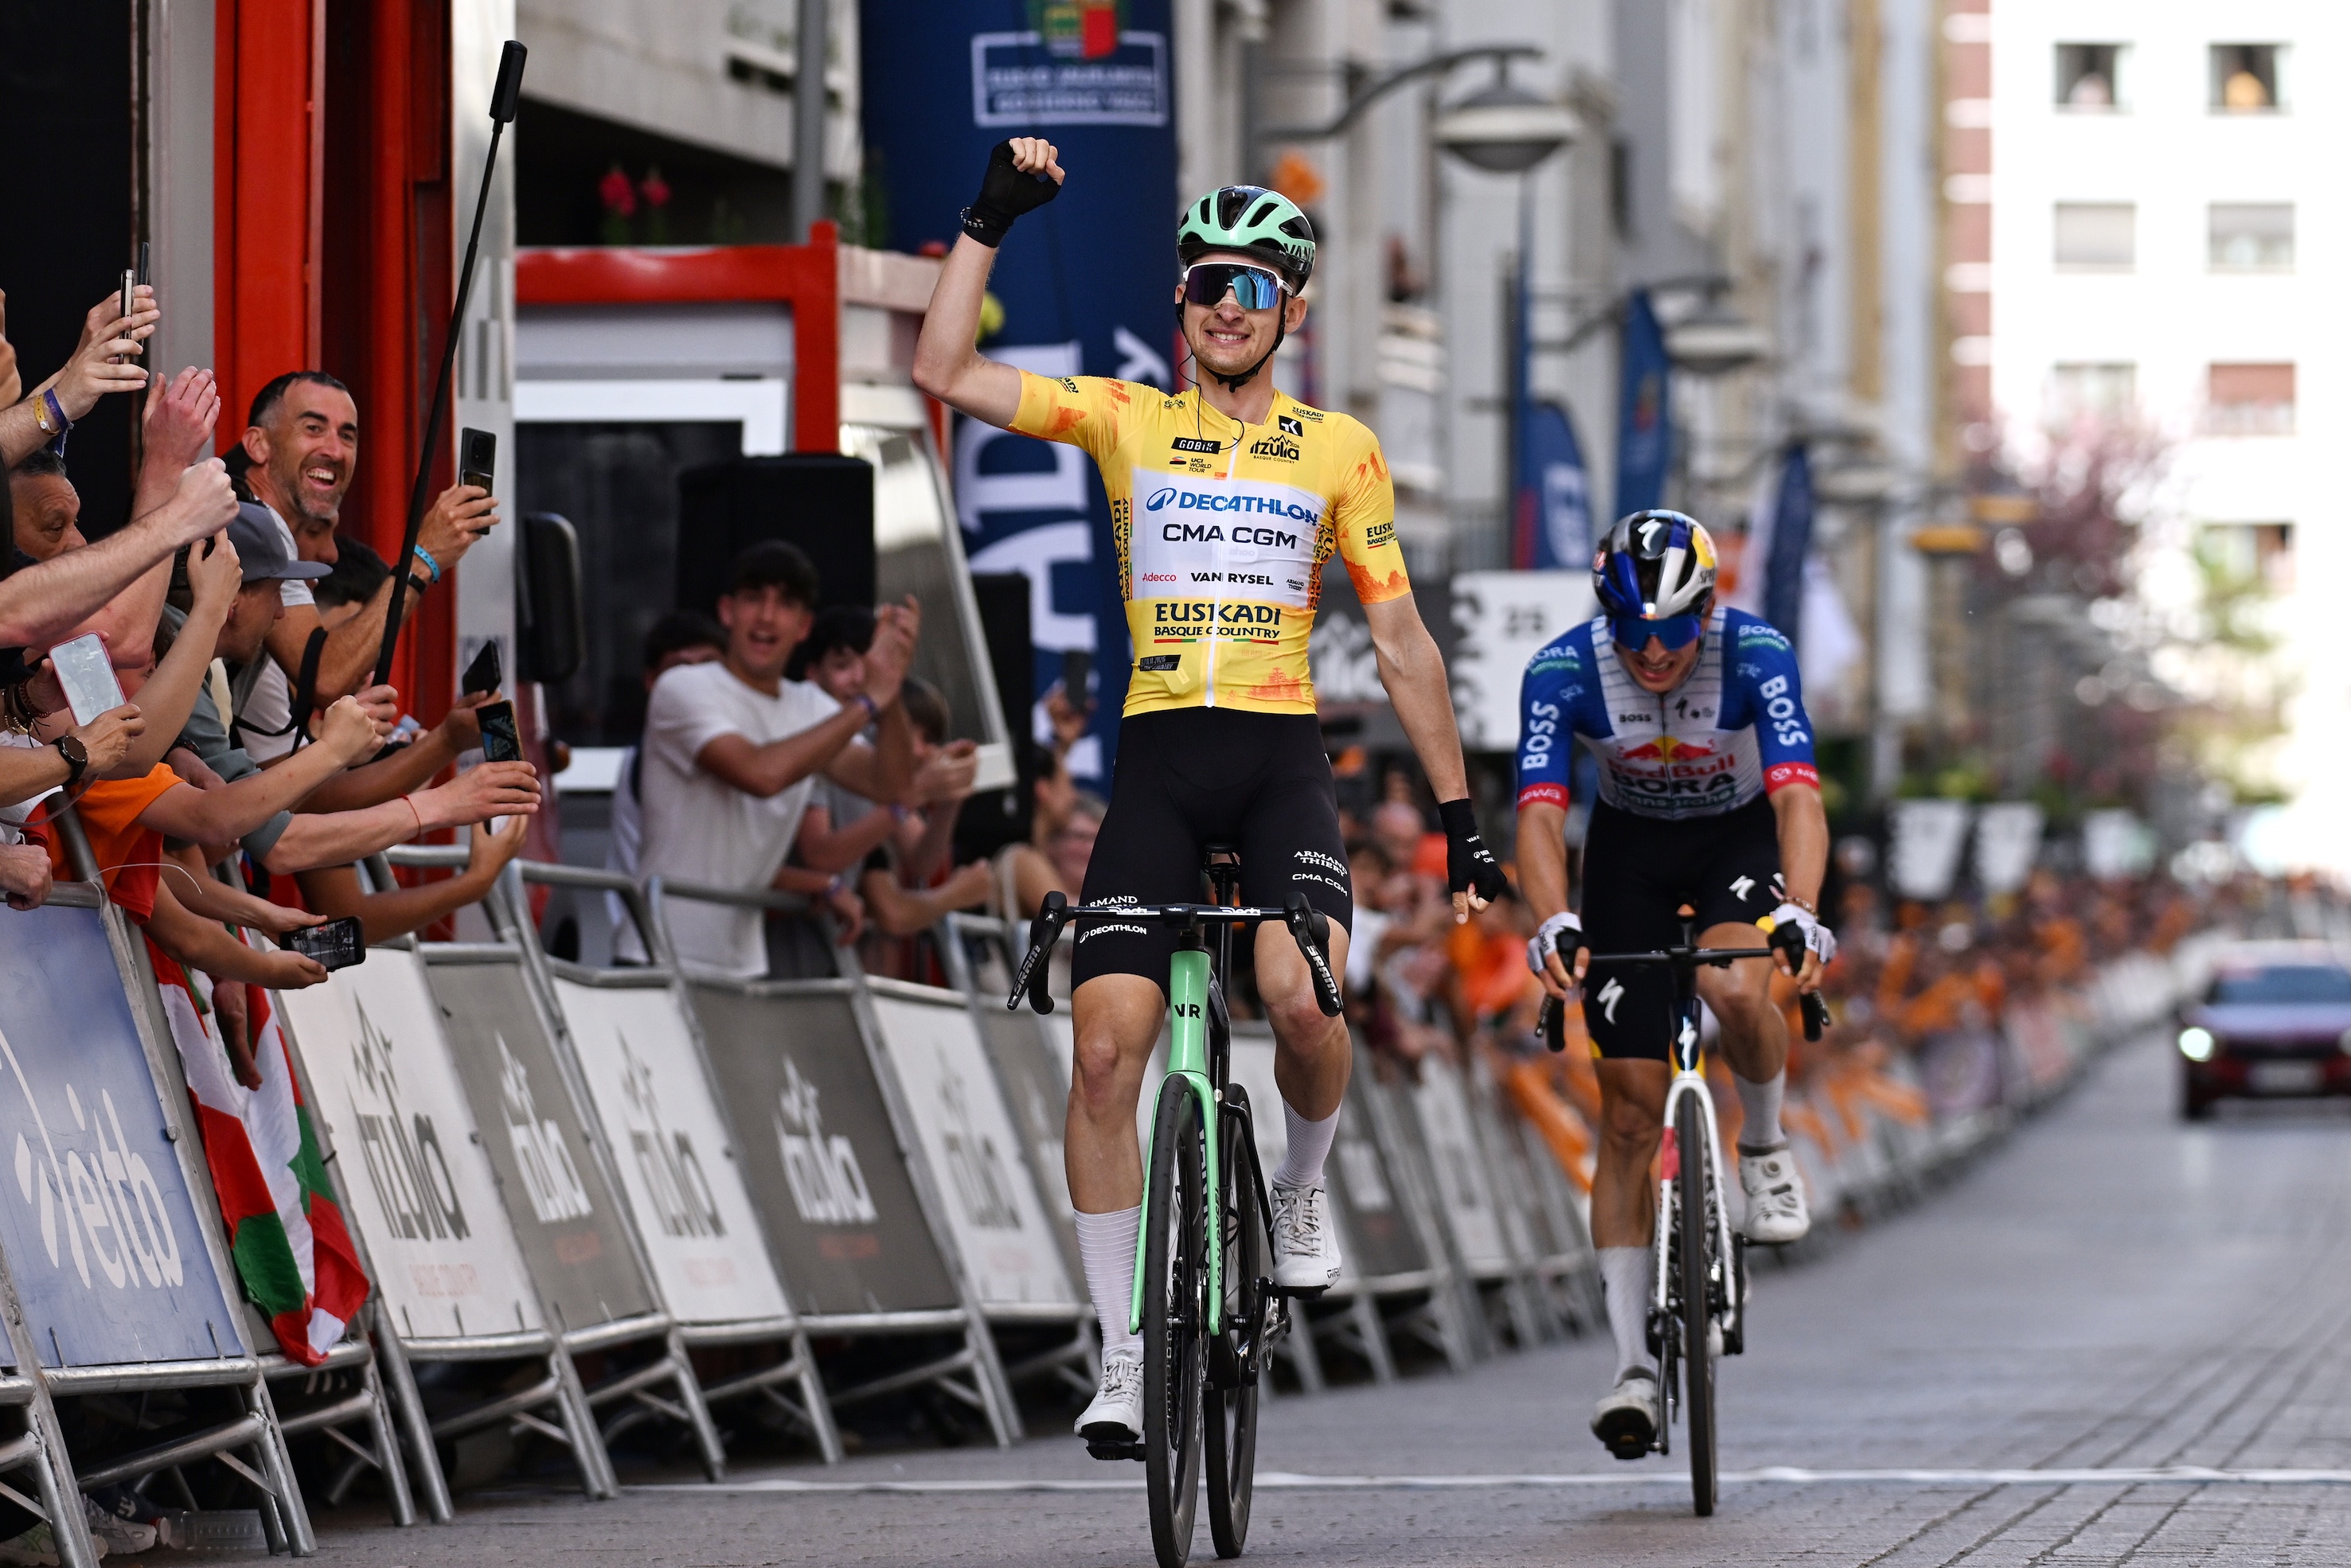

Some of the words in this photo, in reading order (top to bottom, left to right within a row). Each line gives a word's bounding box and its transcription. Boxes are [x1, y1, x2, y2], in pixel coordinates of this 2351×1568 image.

[1293, 407, 1324, 418] EUSKADI
[1178, 492, 1318, 526] DECATHLON
[1162, 523, 1225, 543] CMA
[1232, 527, 1298, 549] CGM
[1142, 572, 1177, 582] Adecco
[1190, 572, 1224, 582] VAN
[1228, 573, 1274, 586] RYSEL
[1154, 603, 1281, 626] EUSKADI
[1154, 626, 1203, 636] BASQUE
[1619, 714, 1652, 724] BOSS
[1759, 675, 1809, 747] BOSS
[1521, 700, 1560, 770] BOSS
[1673, 753, 1736, 778] Bull
[1610, 773, 1736, 794] BORA
[1294, 850, 1348, 875] ARMAND
[1300, 857, 1345, 876] THIERY
[1292, 873, 1322, 882] CMA
[1325, 878, 1348, 896] CGM
[1091, 924, 1147, 935] DECATHLON
[1013, 945, 1041, 995] SRAM
[1306, 945, 1338, 994] SRAM
[1174, 1004, 1201, 1019] VR
